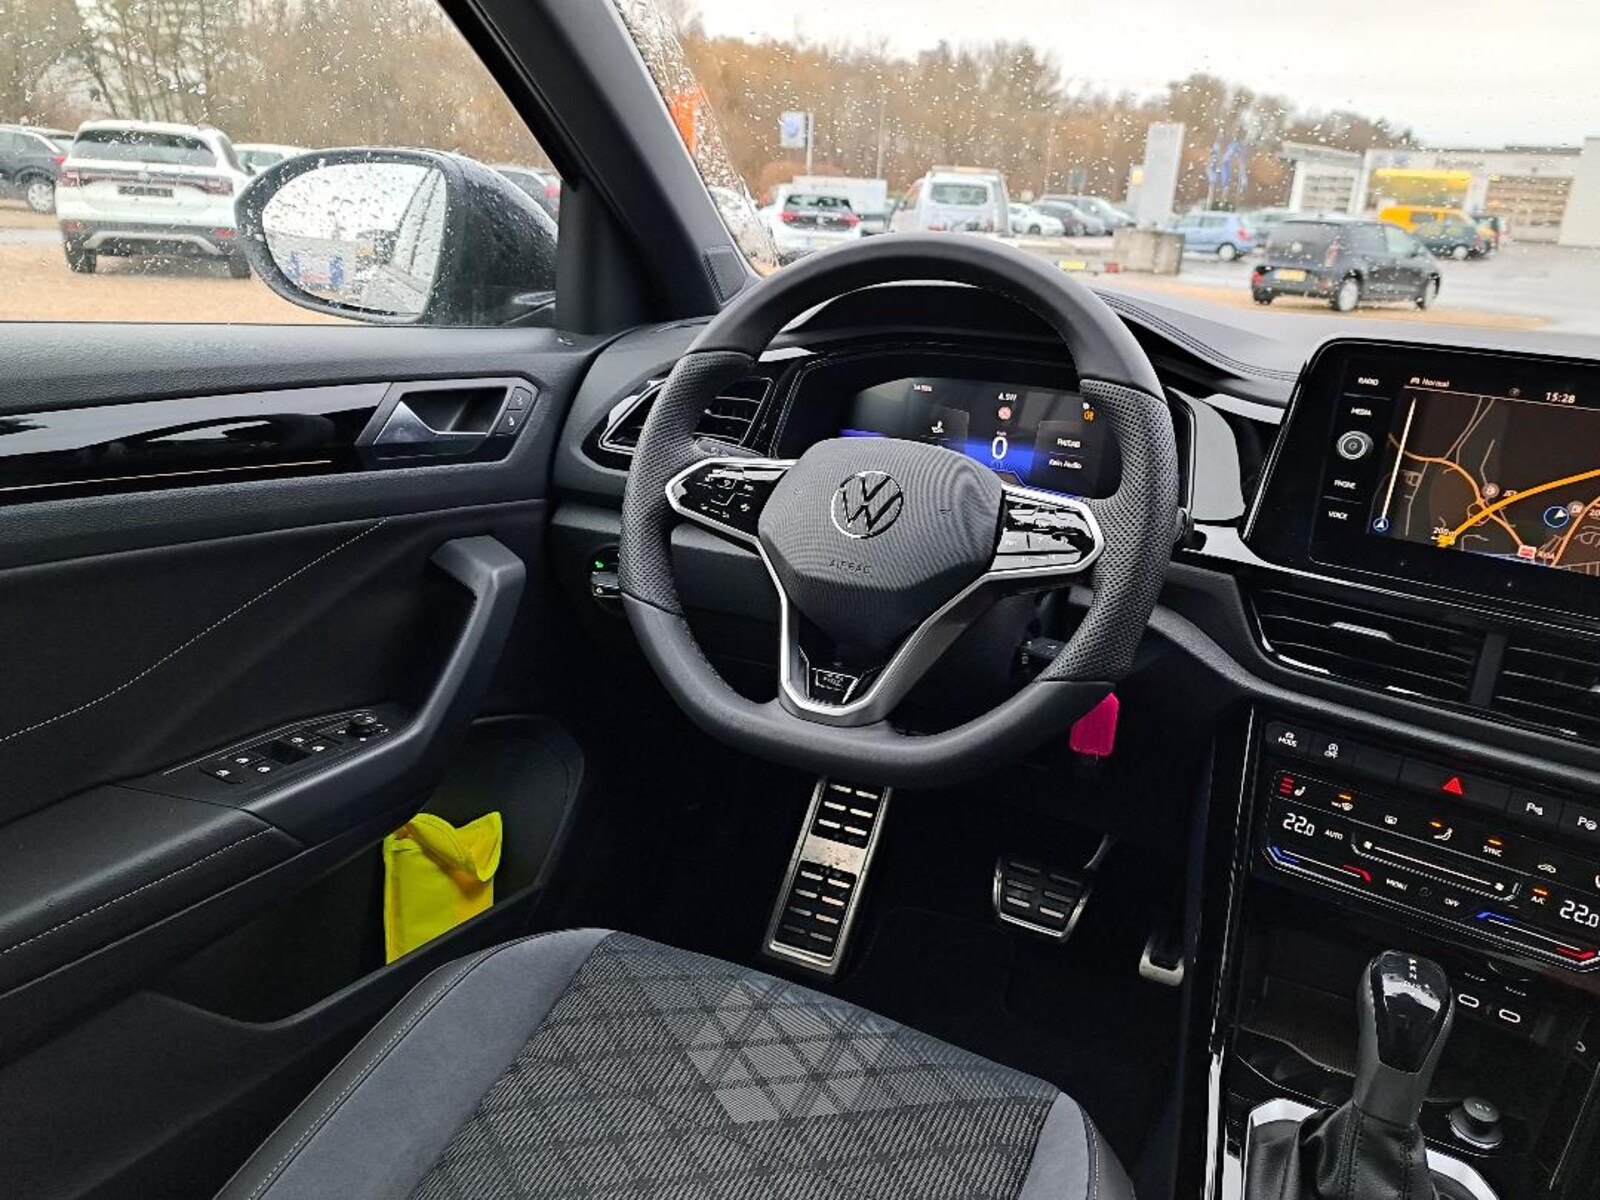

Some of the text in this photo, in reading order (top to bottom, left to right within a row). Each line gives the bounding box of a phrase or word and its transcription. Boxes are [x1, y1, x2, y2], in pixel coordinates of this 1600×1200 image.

[1421, 377, 1450, 388] Normal
[1545, 391, 1576, 404] 15:28
[992, 436, 1008, 460] 0
[1282, 812, 1316, 837] 22.0
[1324, 828, 1344, 840] AUTO
[1482, 844, 1503, 858] SYNC
[1559, 899, 1600, 928] 22.0
